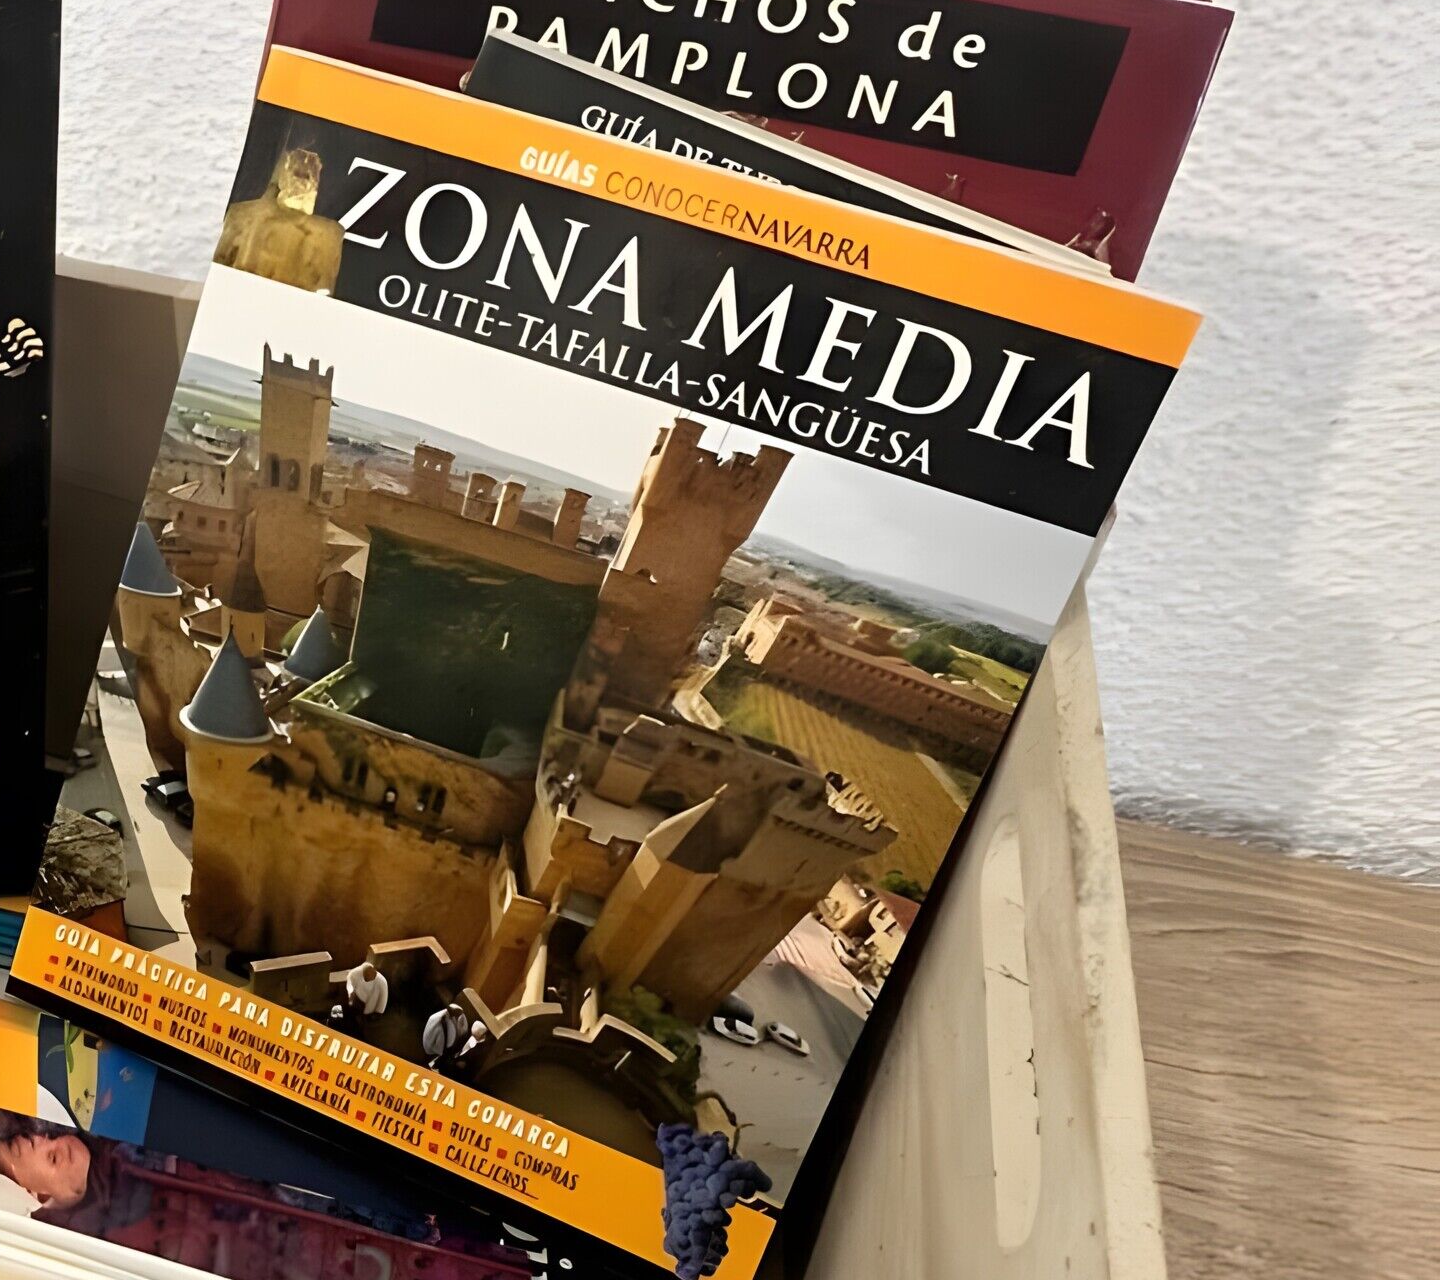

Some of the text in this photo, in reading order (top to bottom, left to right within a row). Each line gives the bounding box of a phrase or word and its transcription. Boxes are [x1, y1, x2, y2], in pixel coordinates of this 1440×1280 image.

[486, 5, 957, 137] PAMPLONA
[898, 11, 987, 69] de
[519, 144, 599, 188] GUÍAS
[339, 156, 1096, 470] ZONA MEDIA
